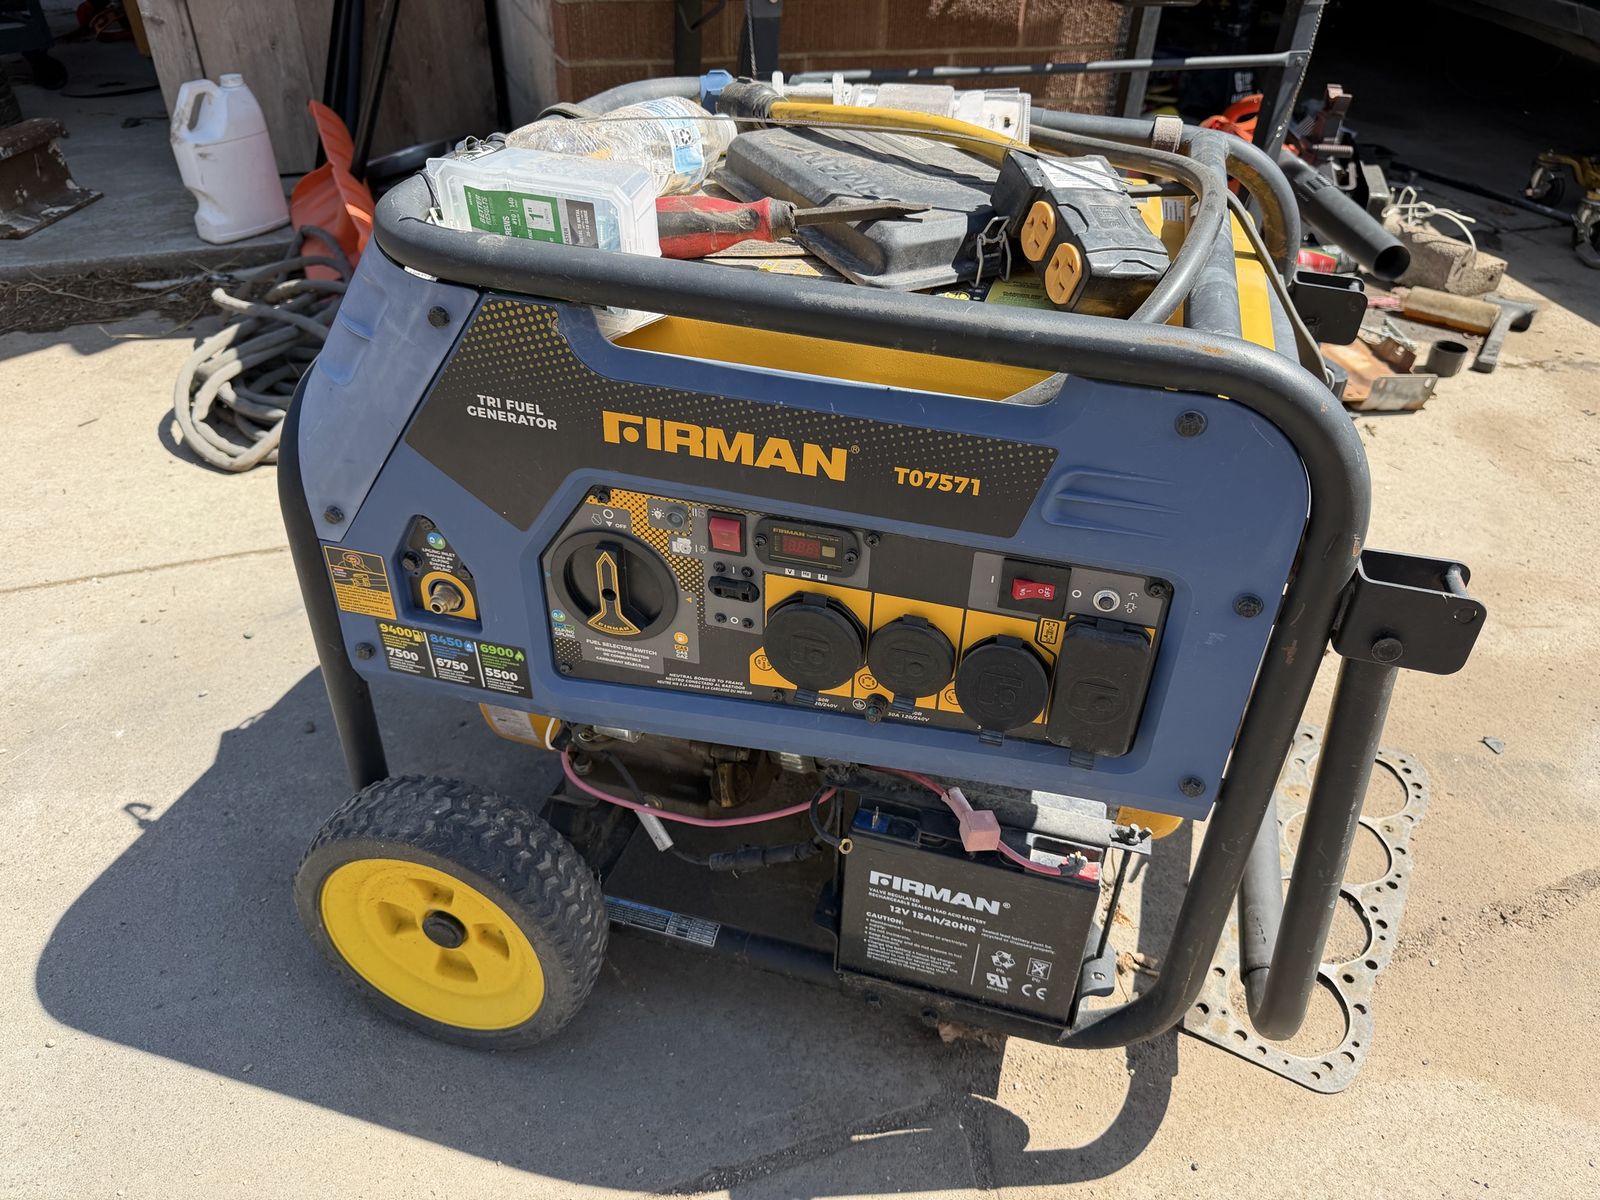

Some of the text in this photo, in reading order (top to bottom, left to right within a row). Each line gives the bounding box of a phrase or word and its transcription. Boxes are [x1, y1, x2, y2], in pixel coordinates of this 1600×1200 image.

[503, 216, 512, 236] REWS
[477, 394, 544, 416] TRI FUEL
[466, 405, 558, 430] GENERATOR
[894, 466, 982, 496] T07571
[380, 623, 412, 638] 9400
[430, 634, 463, 648] 8450
[386, 646, 419, 661] 7500
[480, 644, 514, 658] 6900
[602, 642, 632, 651] SELECTOR
[634, 647, 658, 656] SWITCH
[436, 658, 468, 672] 6750
[484, 667, 518, 682] 5500
[869, 887, 920, 903] VALVE REGULATED
[868, 892, 910, 906] RECHARGEABLE
[911, 902, 932, 911] SEALED
[932, 907, 947, 915] LEAD
[962, 916, 986, 925] BATTERY
[866, 911, 904, 925] CAUTION:
[890, 904, 976, 934] 12V 15Ah/20HR
